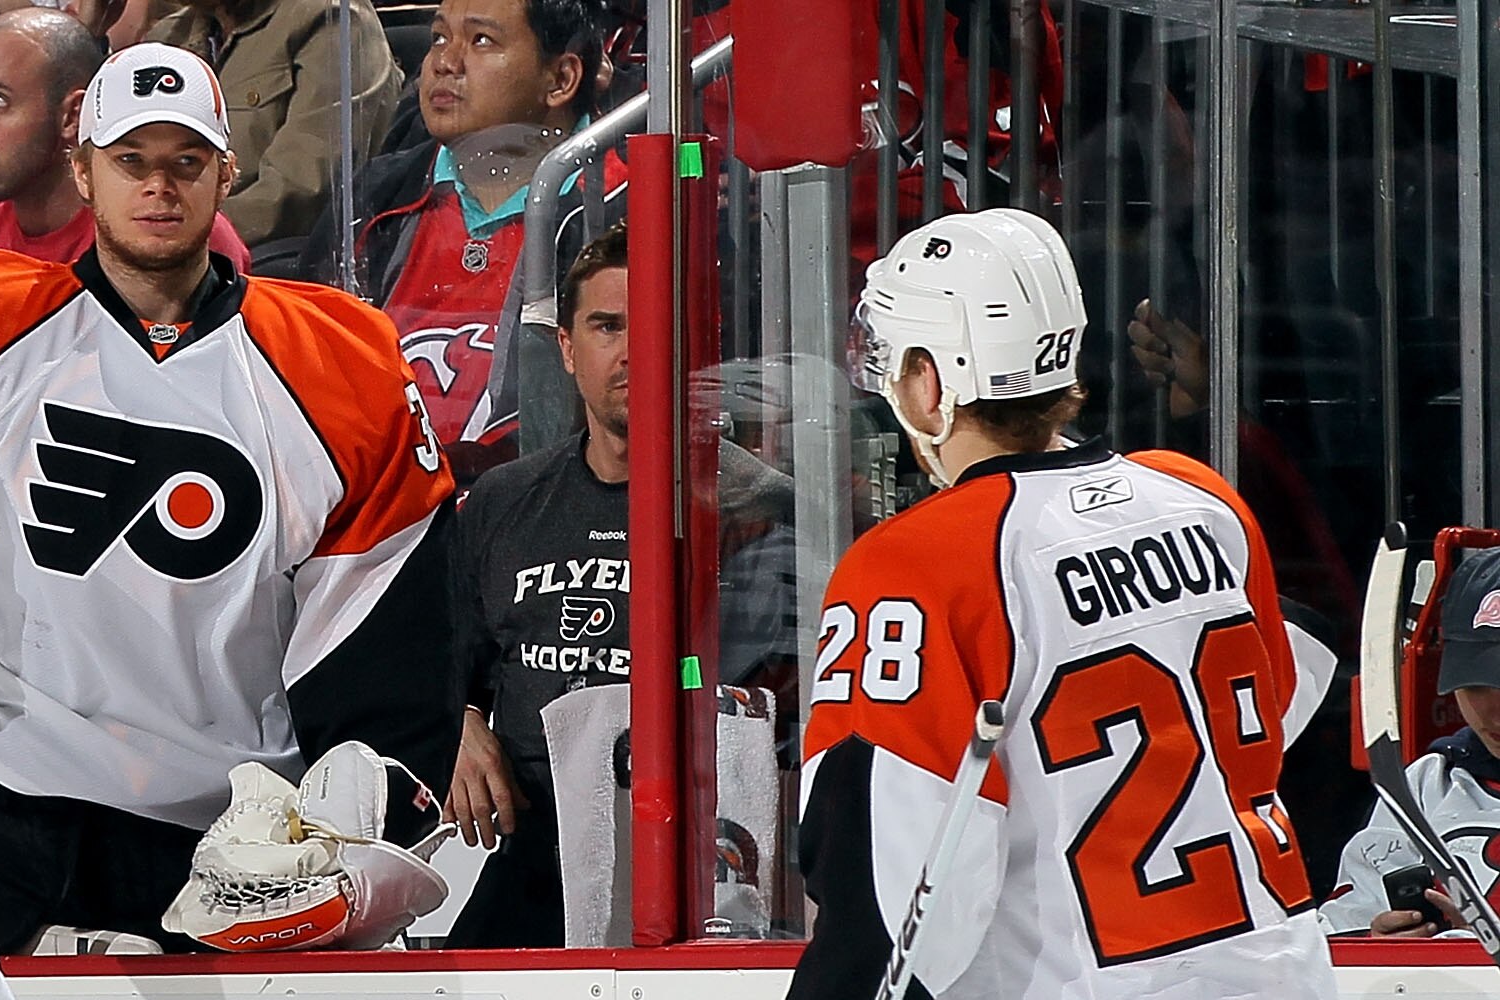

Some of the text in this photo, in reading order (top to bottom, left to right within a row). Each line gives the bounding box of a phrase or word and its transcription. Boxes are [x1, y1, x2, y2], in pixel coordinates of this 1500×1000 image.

[1035, 327, 1076, 375] 28
[589, 530, 627, 541] Reebok
[1055, 523, 1237, 627] GIROUX
[810, 596, 927, 706] 28
[1030, 611, 1317, 969] 28
